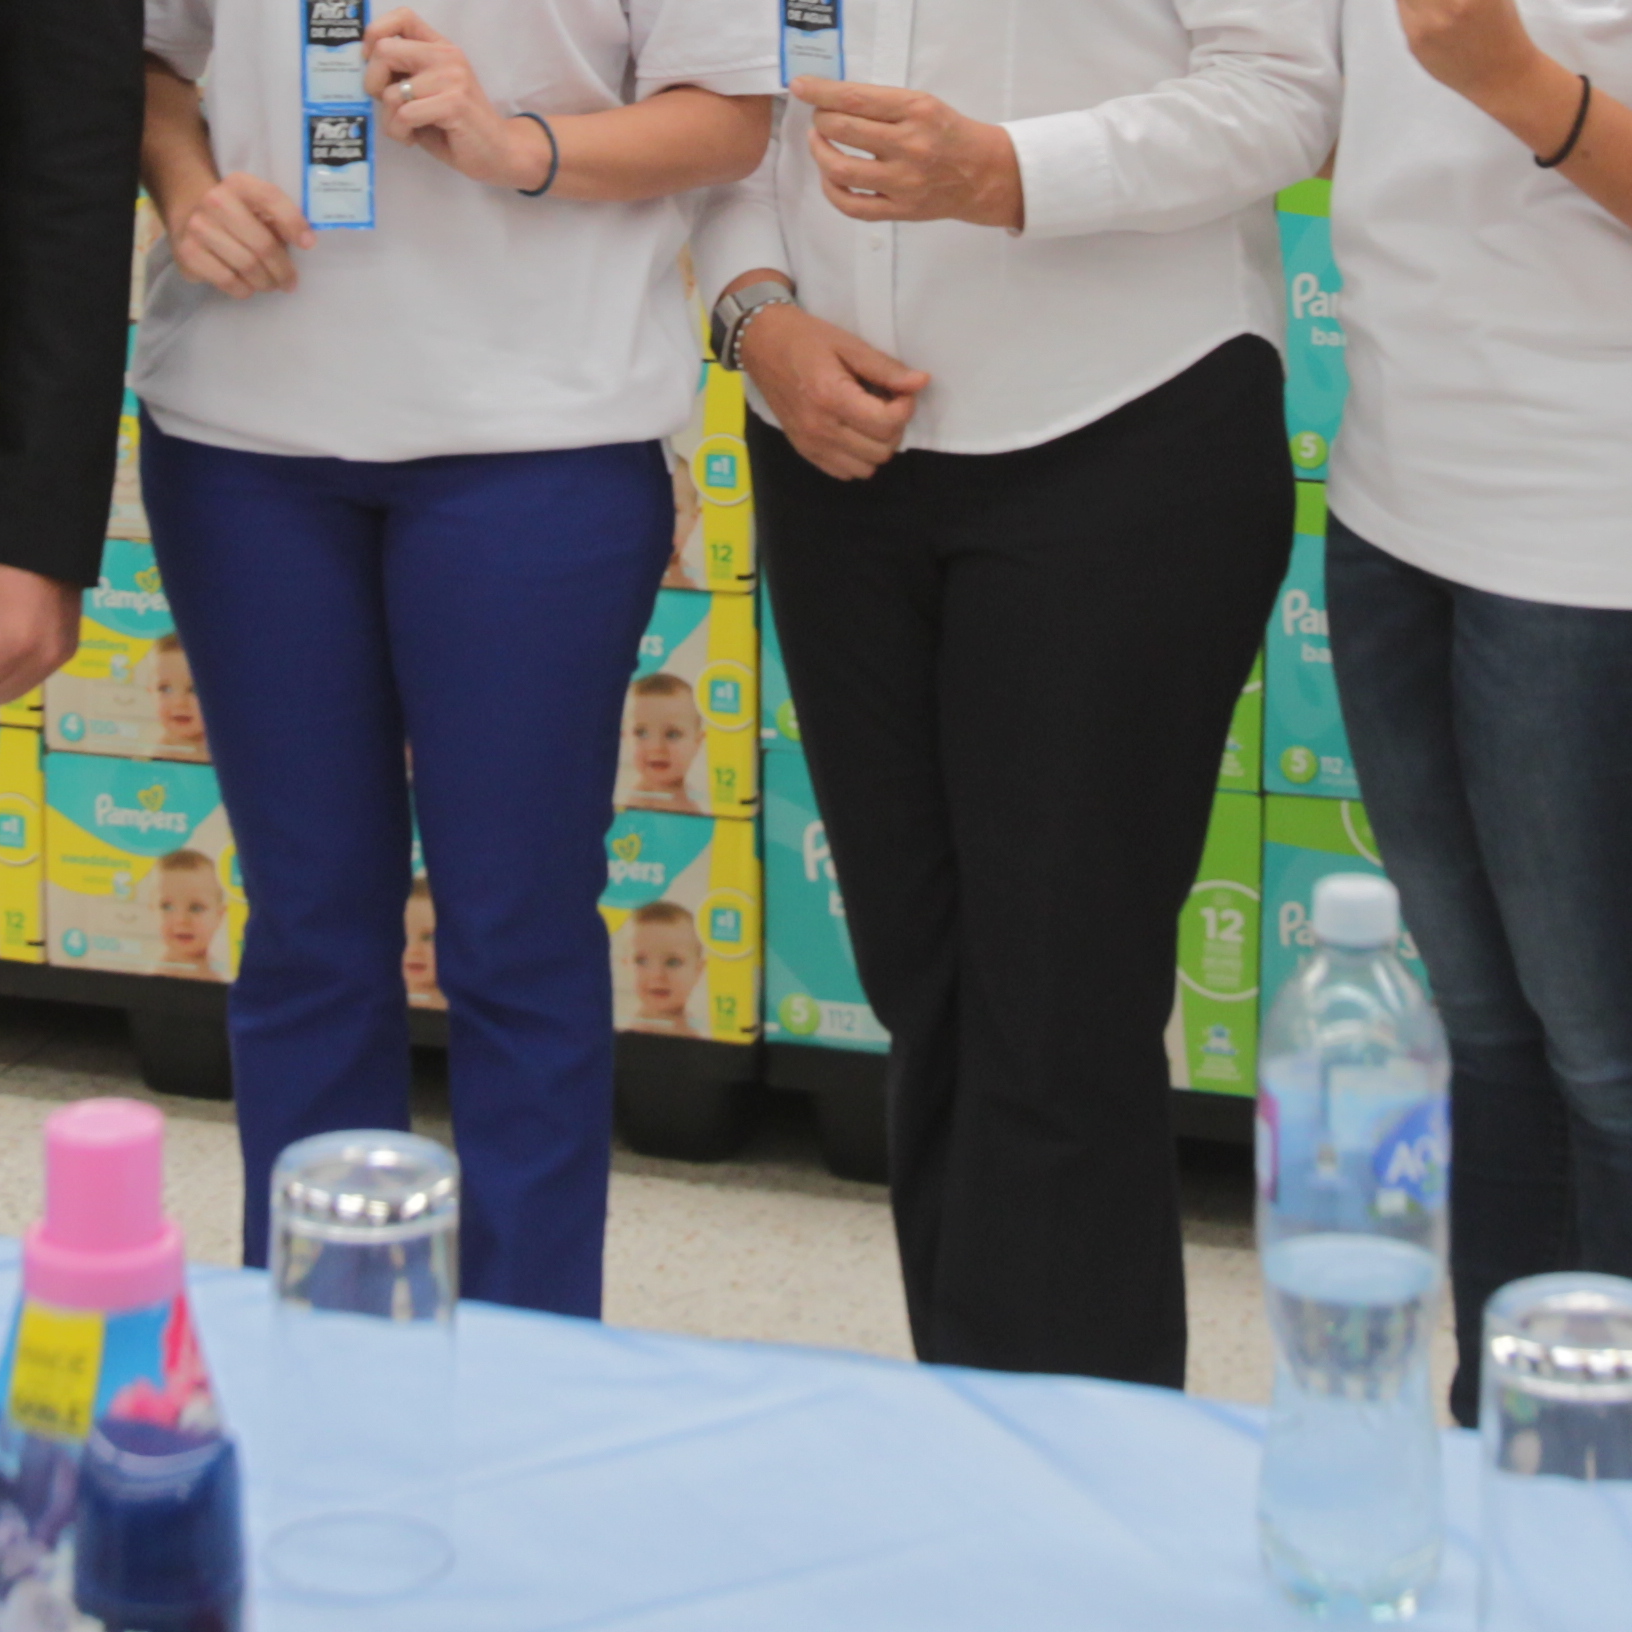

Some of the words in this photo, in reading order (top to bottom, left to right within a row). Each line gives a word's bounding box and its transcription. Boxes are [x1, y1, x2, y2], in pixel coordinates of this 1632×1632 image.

[804, 9, 833, 26] AGUA
[328, 28, 360, 39] AGUA
[330, 146, 363, 159] AGUA
[1298, 434, 1317, 459] 5
[709, 544, 734, 563] 12
[93, 576, 171, 616] Pampe
[94, 793, 188, 834] Pampers
[1201, 908, 1245, 944] 12
[714, 996, 737, 1016] 12
[789, 996, 810, 1022] 5
[827, 1009, 856, 1032] 112
